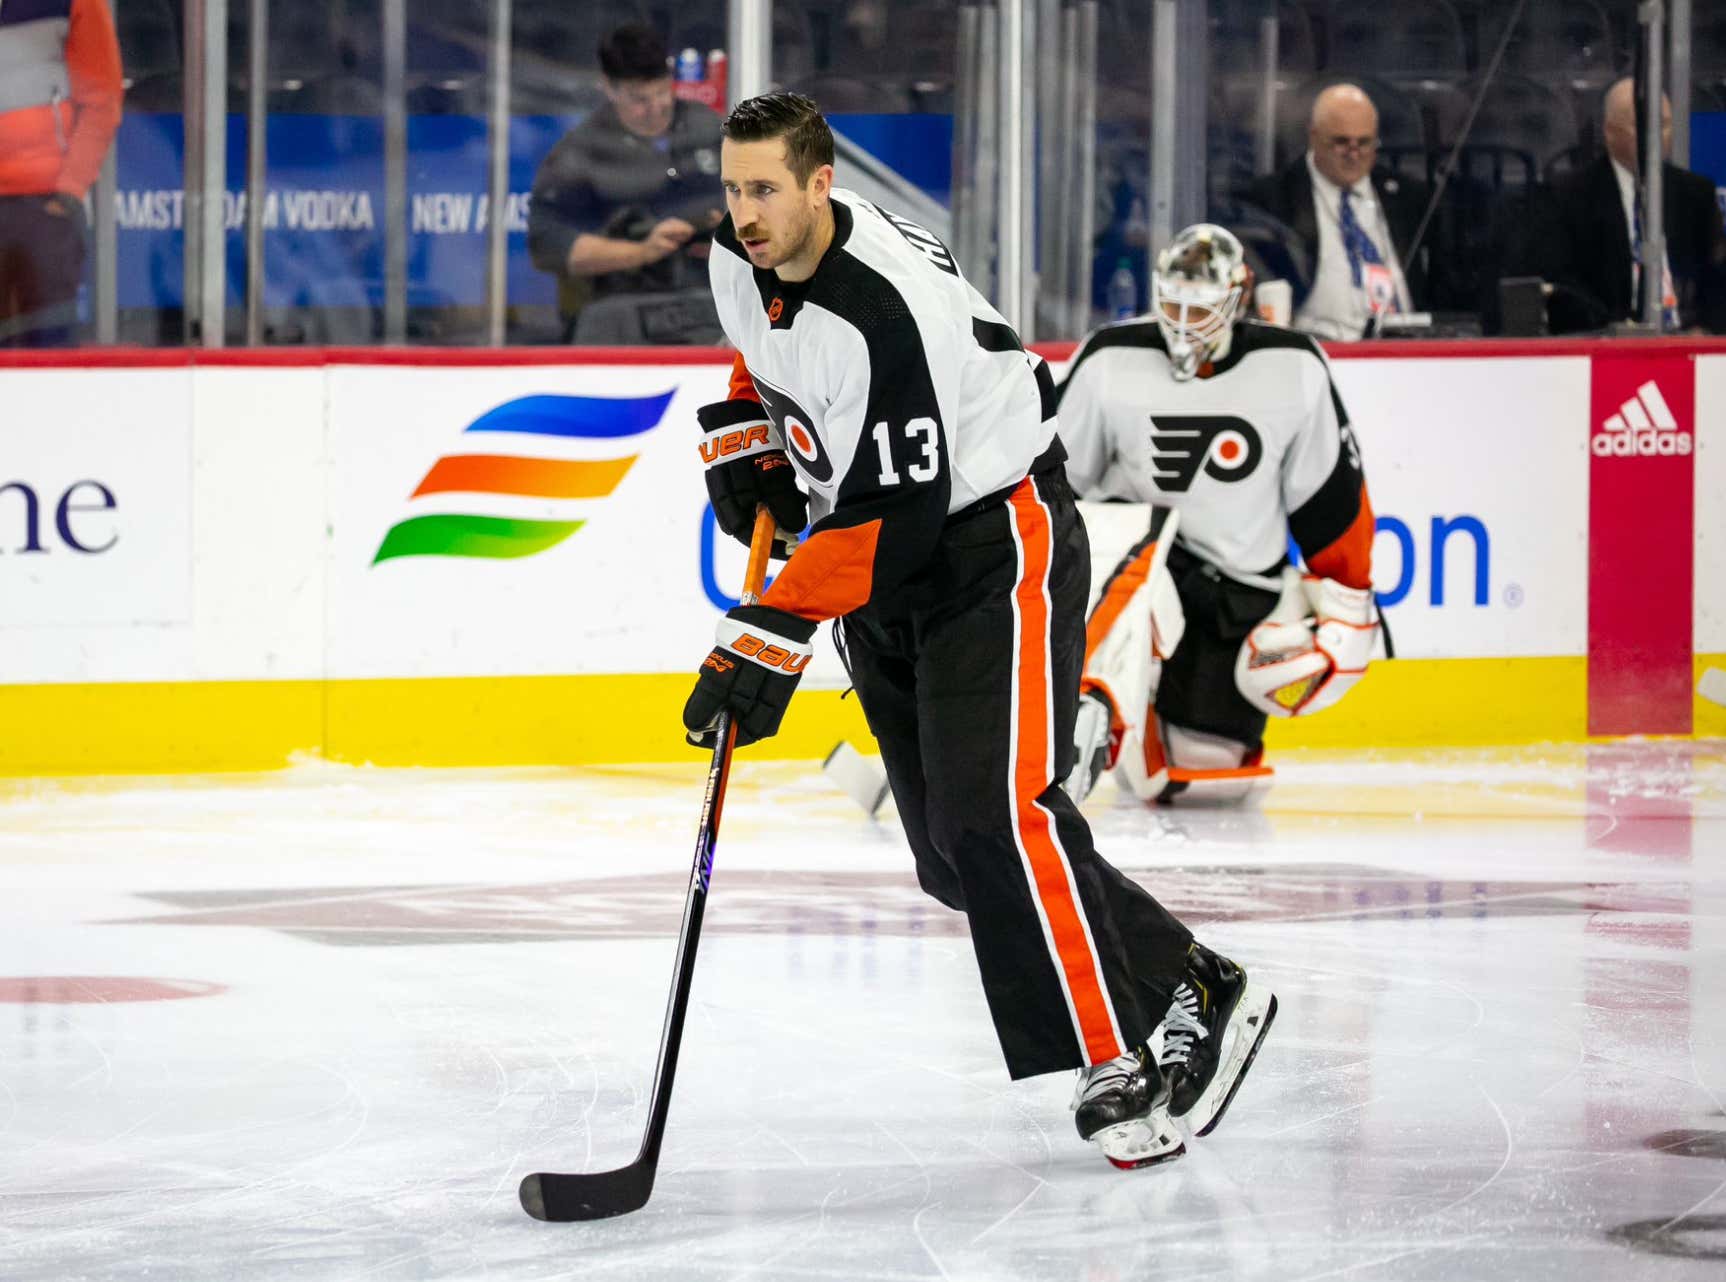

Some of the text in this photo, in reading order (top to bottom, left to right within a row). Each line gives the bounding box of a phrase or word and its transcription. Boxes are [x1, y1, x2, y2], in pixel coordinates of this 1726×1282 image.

[285, 191, 374, 230] VODKA
[412, 192, 473, 234] NEW
[872, 416, 939, 486] 13
[1592, 427, 1692, 457] adidas
